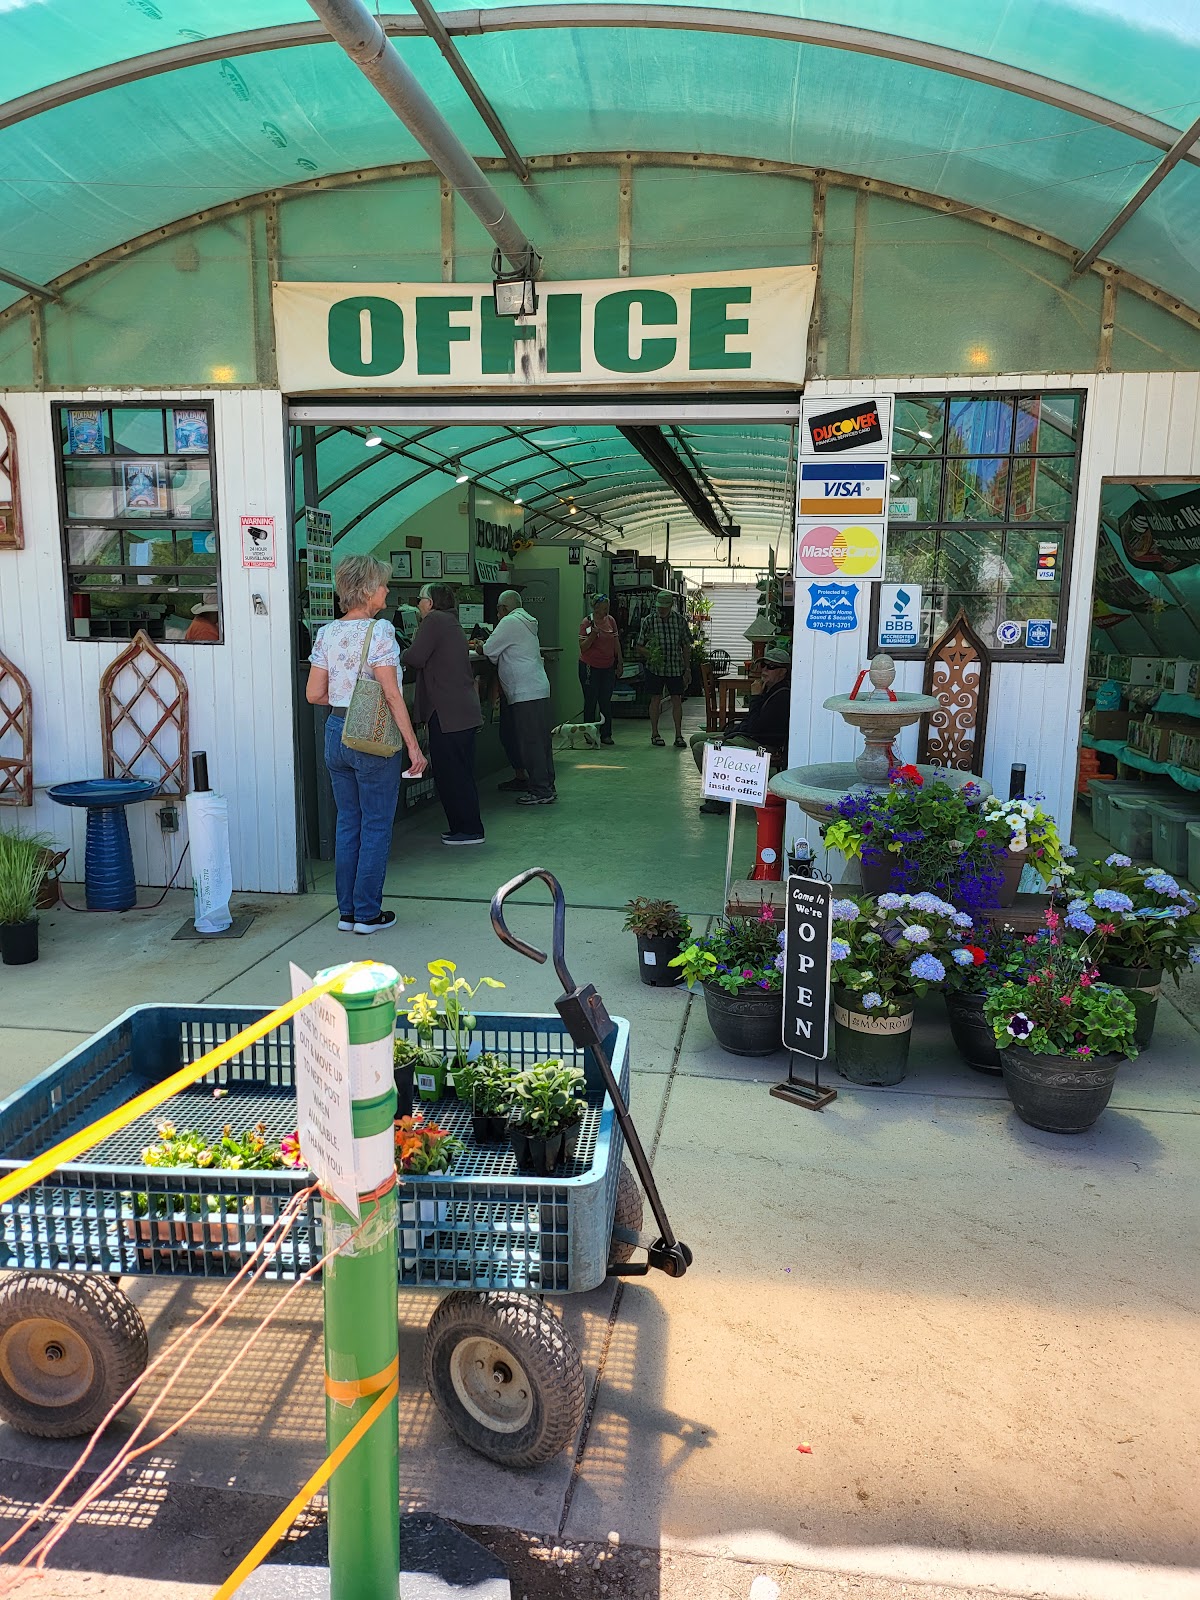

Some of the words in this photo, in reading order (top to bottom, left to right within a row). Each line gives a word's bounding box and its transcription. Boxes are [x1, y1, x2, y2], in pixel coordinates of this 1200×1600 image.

[328, 286, 752, 377] OFFICE
[813, 412, 878, 442] DISCOVER
[815, 436, 838, 446] FINANCIAL
[837, 431, 858, 440] SERVICES
[824, 482, 862, 496] VISA
[241, 517, 274, 525] WARNING
[801, 545, 878, 558] MasterCard
[885, 621, 913, 631] BBB
[713, 756, 761, 773] Please!
[712, 772, 730, 781] NO!
[735, 776, 758, 786] Carts
[708, 781, 735, 792] inside
[737, 787, 762, 796] office
[792, 888, 814, 903] Come
[816, 894, 825, 905] In
[795, 904, 823, 918] We're
[795, 922, 816, 1039] OPEN
[318, 1004, 336, 1028] WAIT
[860, 1016, 912, 1030] MONROVI
[320, 1033, 341, 1060] CHECK
[300, 1031, 310, 1051] OUT
[315, 1049, 332, 1077] MOVE
[333, 1067, 343, 1084] UP
[303, 1056, 310, 1073] TO
[311, 1066, 323, 1090] NEXT
[324, 1082, 340, 1107] POST
[313, 1090, 330, 1119] WHEN
[307, 1129, 325, 1161] THANK
[326, 1152, 344, 1180] YOU!
